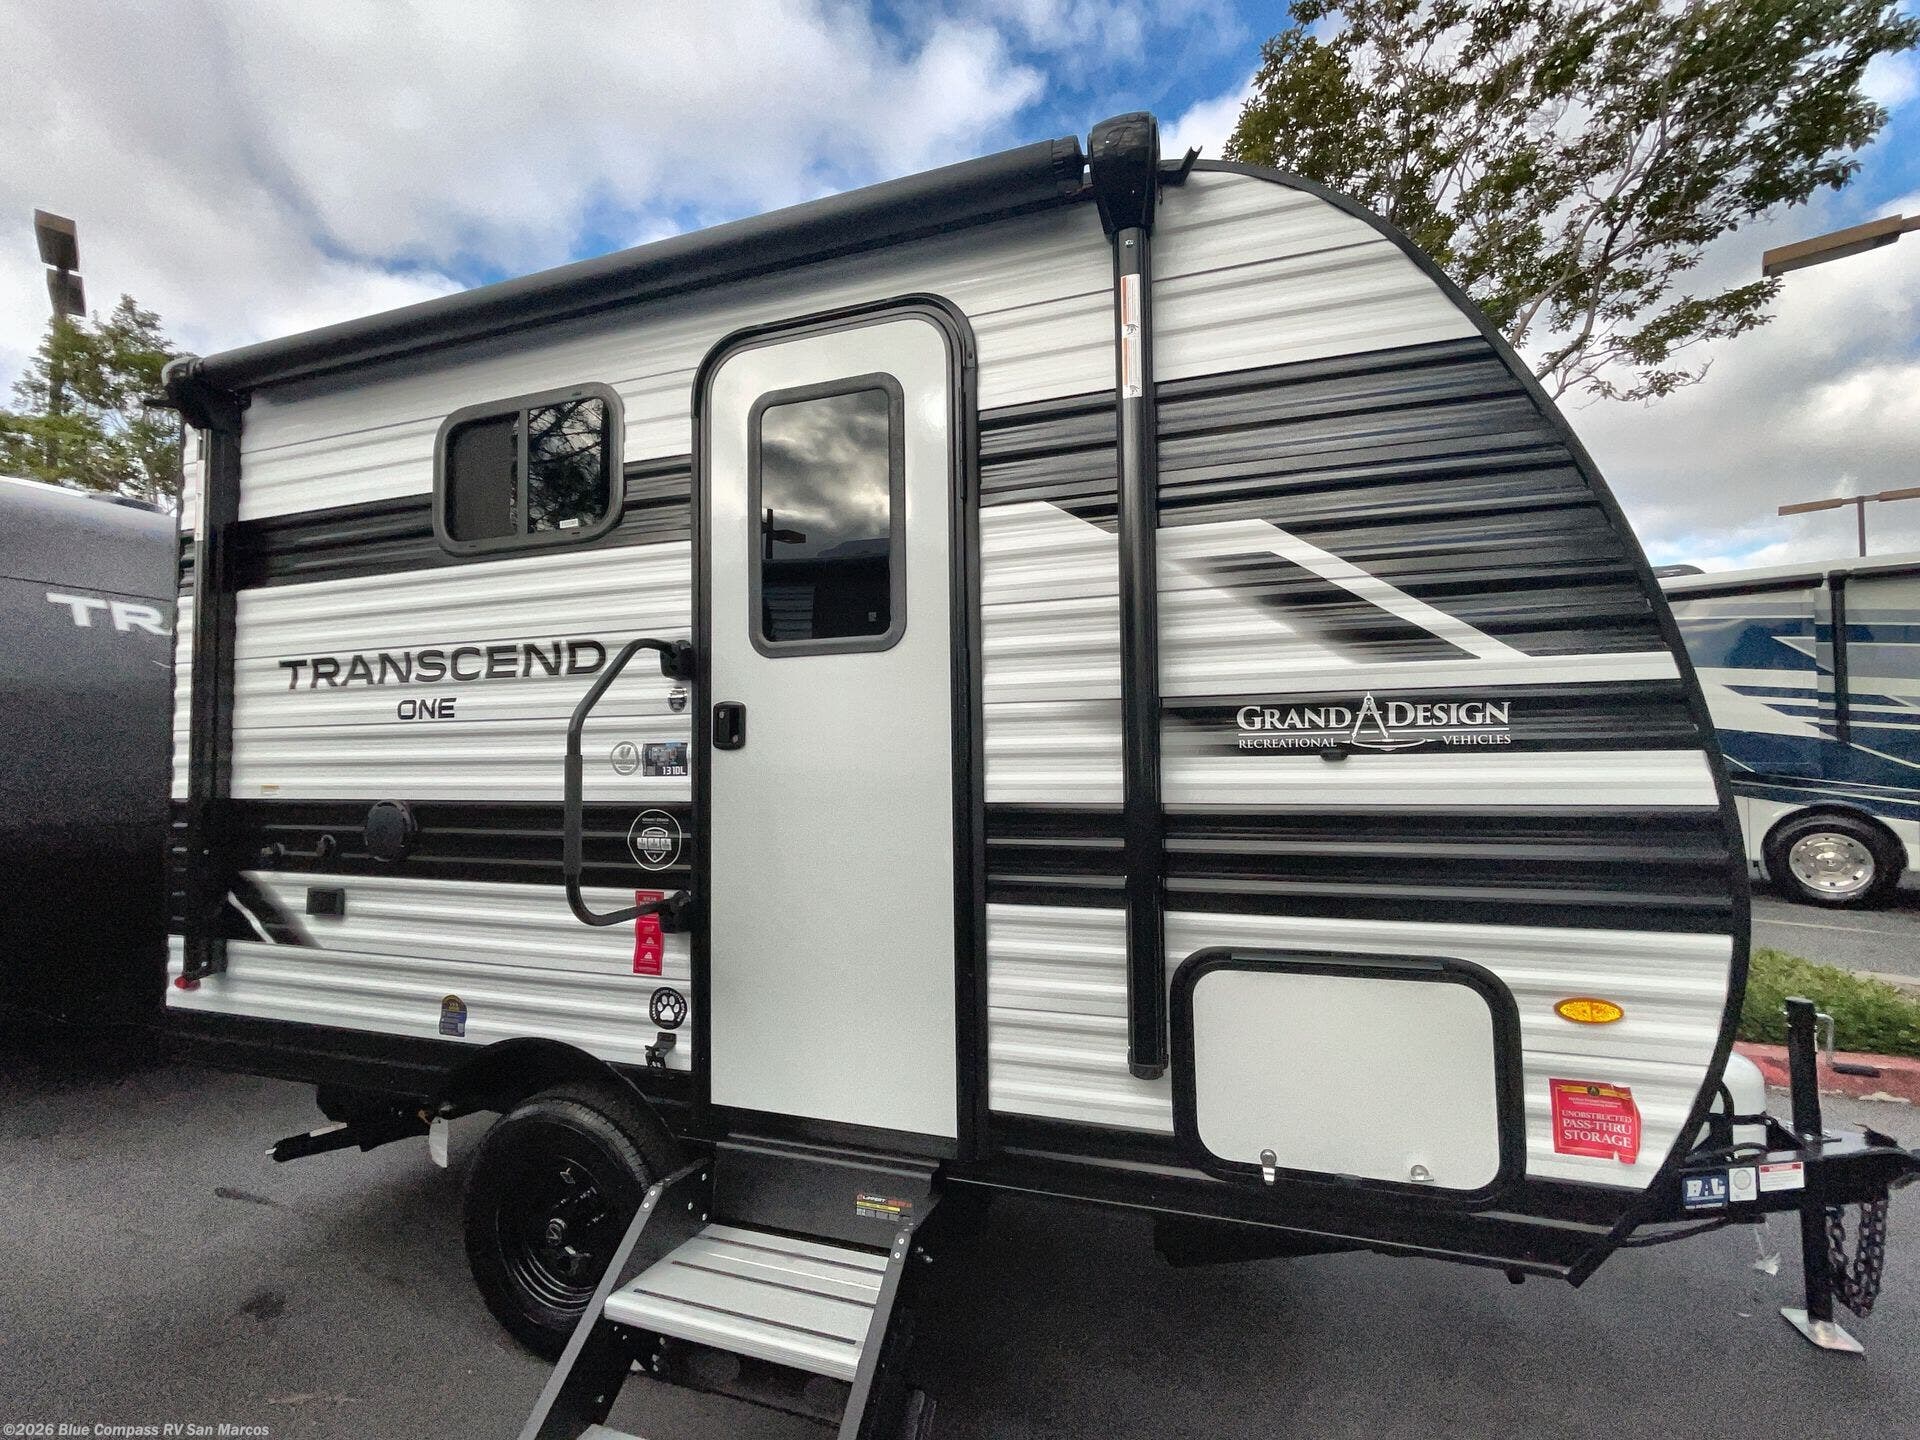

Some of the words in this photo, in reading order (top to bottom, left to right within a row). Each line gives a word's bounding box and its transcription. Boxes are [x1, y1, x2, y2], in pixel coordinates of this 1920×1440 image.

[278, 639, 607, 690] TRANSCEND
[397, 697, 457, 720] ONE
[1236, 705, 1352, 731] GRAND
[1384, 700, 1511, 728] DESIGN
[1238, 737, 1338, 750] RECREATIONAL
[1442, 733, 1512, 746] VEHICLES
[1561, 1109, 1632, 1123] UNOBSTRUCTED
[1563, 1118, 1632, 1135] PASS-THRU
[1564, 1129, 1632, 1149] STORAGE
